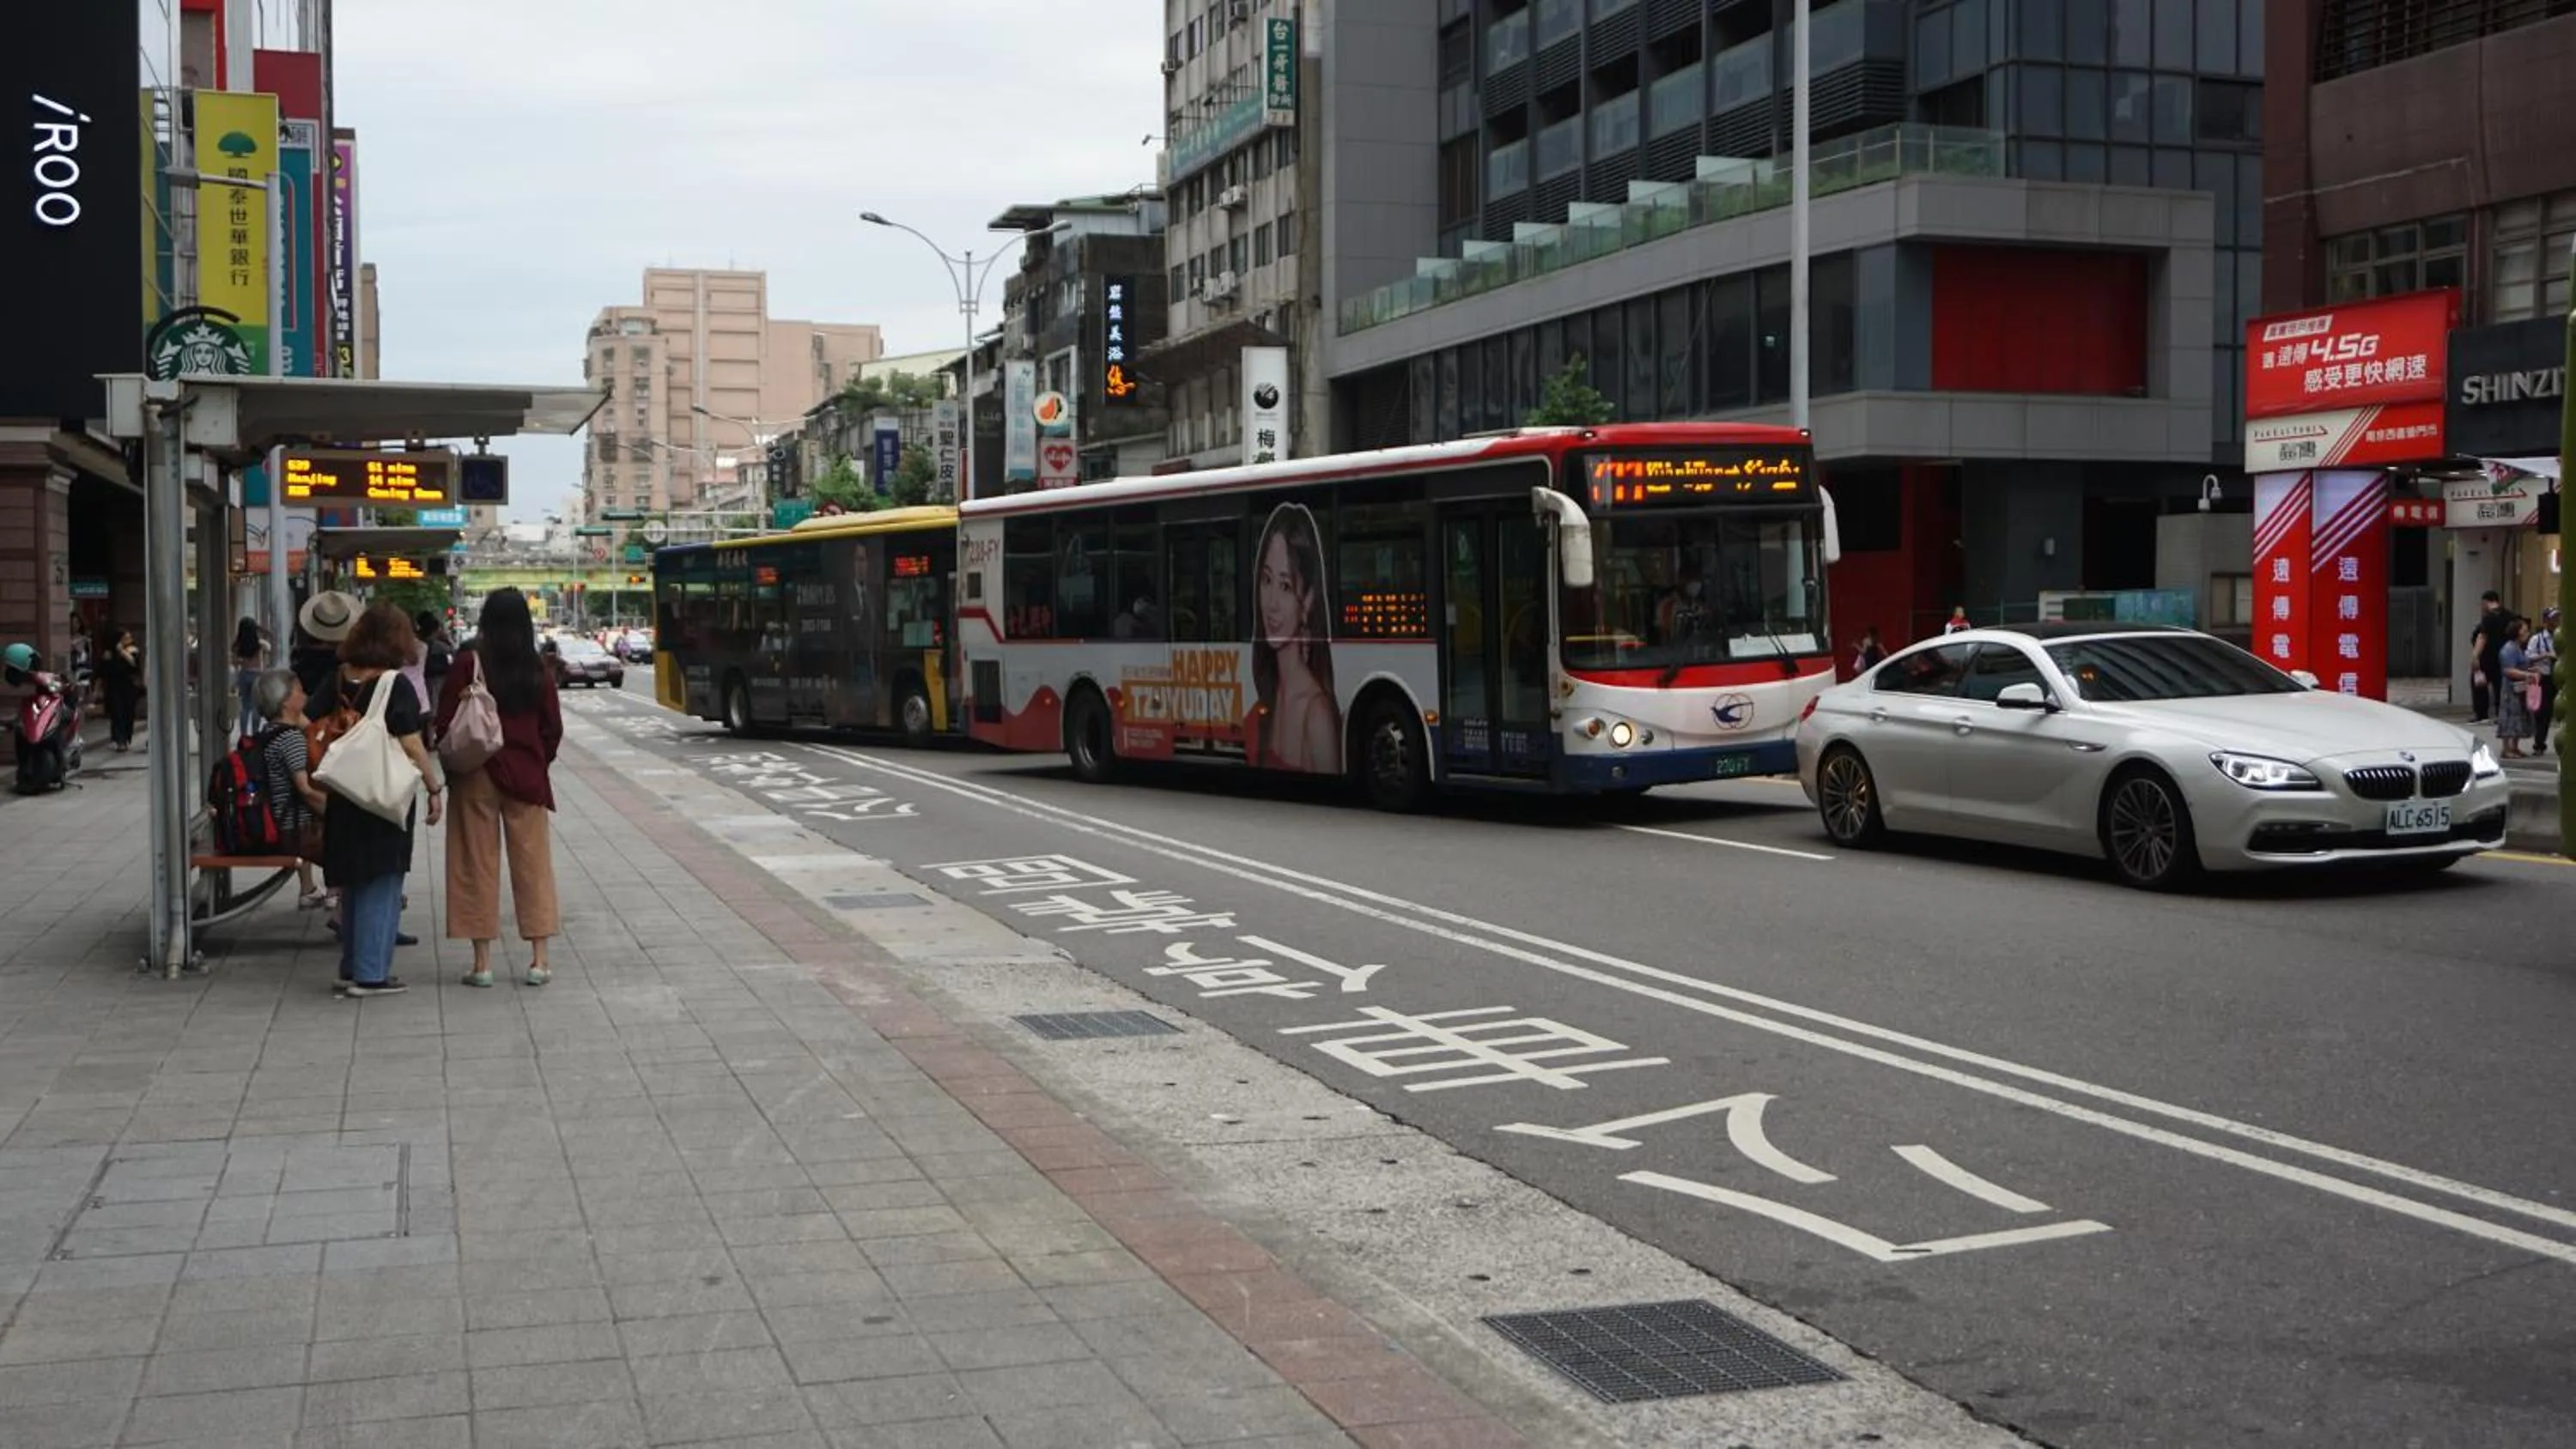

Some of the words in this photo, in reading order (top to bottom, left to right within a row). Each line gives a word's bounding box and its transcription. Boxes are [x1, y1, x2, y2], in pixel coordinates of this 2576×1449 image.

[2304, 355, 2427, 392] 感受更快網速
[2338, 557, 2359, 695] 遠傳電信
[1172, 649, 1239, 685] HAPPY
